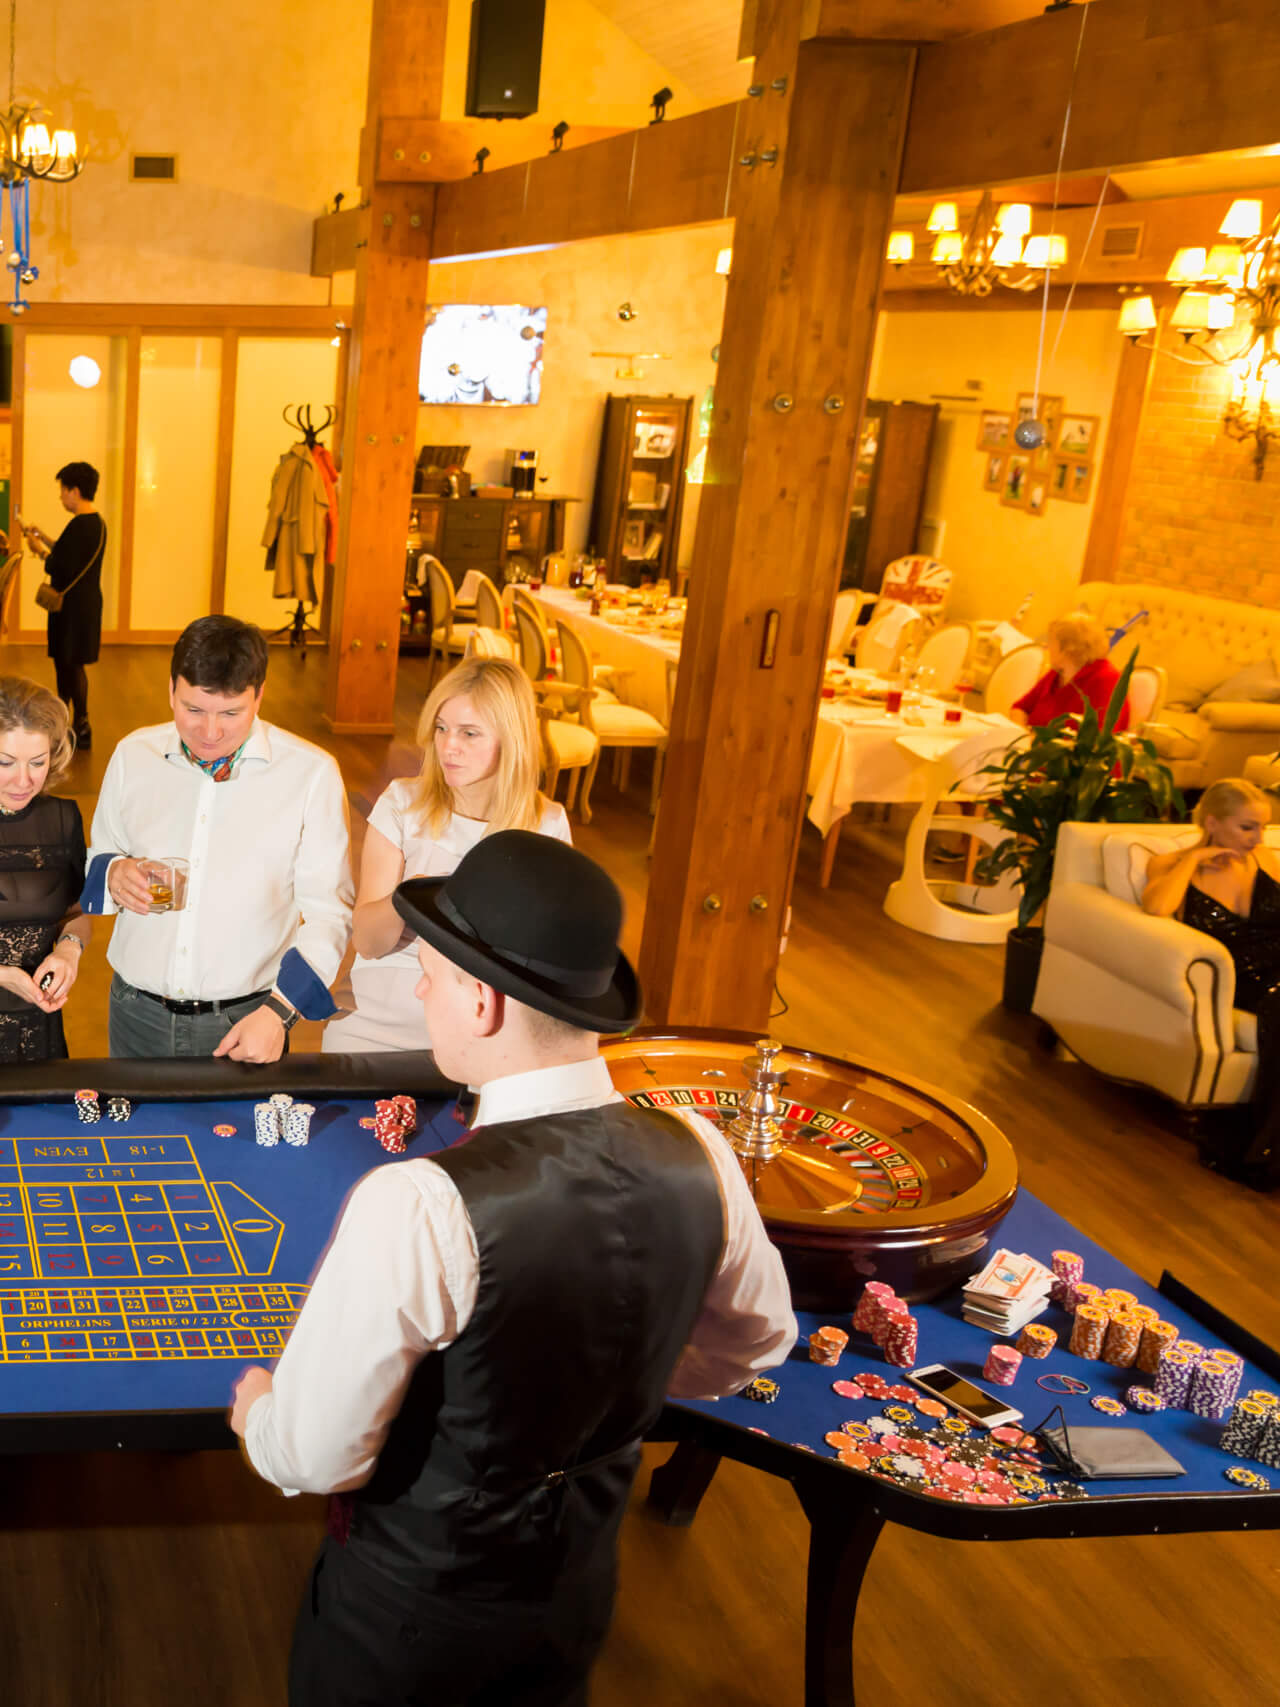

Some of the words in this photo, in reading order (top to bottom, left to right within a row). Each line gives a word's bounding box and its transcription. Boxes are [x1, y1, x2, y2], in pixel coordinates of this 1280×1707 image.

[652, 1093, 672, 1106] 23
[673, 1091, 692, 1104] 10
[698, 1091, 710, 1104] 5
[719, 1092, 736, 1105] 24
[797, 1108, 807, 1120] 1
[813, 1114, 835, 1128] 20
[833, 1123, 855, 1136] 14
[851, 1133, 876, 1147] 31
[35, 1146, 89, 1157] EVEN
[129, 1145, 165, 1155] 1-18
[871, 1145, 890, 1155] 9
[882, 1155, 907, 1169] 22
[86, 1168, 105, 1178] 12
[37, 1192, 63, 1207] 10
[84, 1195, 108, 1203] 7
[130, 1193, 153, 1203] 4
[43, 1223, 69, 1236] 11
[90, 1224, 117, 1233] 8
[137, 1223, 163, 1232] 5
[185, 1222, 210, 1231] 2
[232, 1219, 274, 1233] 0
[48, 1253, 75, 1270] 12
[97, 1255, 124, 1265] 9
[147, 1254, 175, 1265] 6
[195, 1254, 221, 1263] 3
[28, 1301, 44, 1311] 20
[53, 1301, 69, 1310] 14
[77, 1301, 91, 1310] 31
[125, 1300, 142, 1309] 22
[174, 1299, 189, 1308] 29
[201, 1298, 209, 1307] 7
[222, 1297, 238, 1307] 28
[247, 1297, 263, 1306] 12
[270, 1296, 286, 1306] 35
[8, 1302, 15, 1311] 1
[20, 1319, 111, 1329] ORPHELINS
[131, 1318, 178, 1327] SERIE
[103, 1336, 117, 1346] 17
[164, 1335, 173, 1345] 2
[184, 1335, 201, 1345] 21
[214, 1334, 223, 1344] 4
[261, 1332, 277, 1342] 15
[21, 1338, 30, 1348] 6
